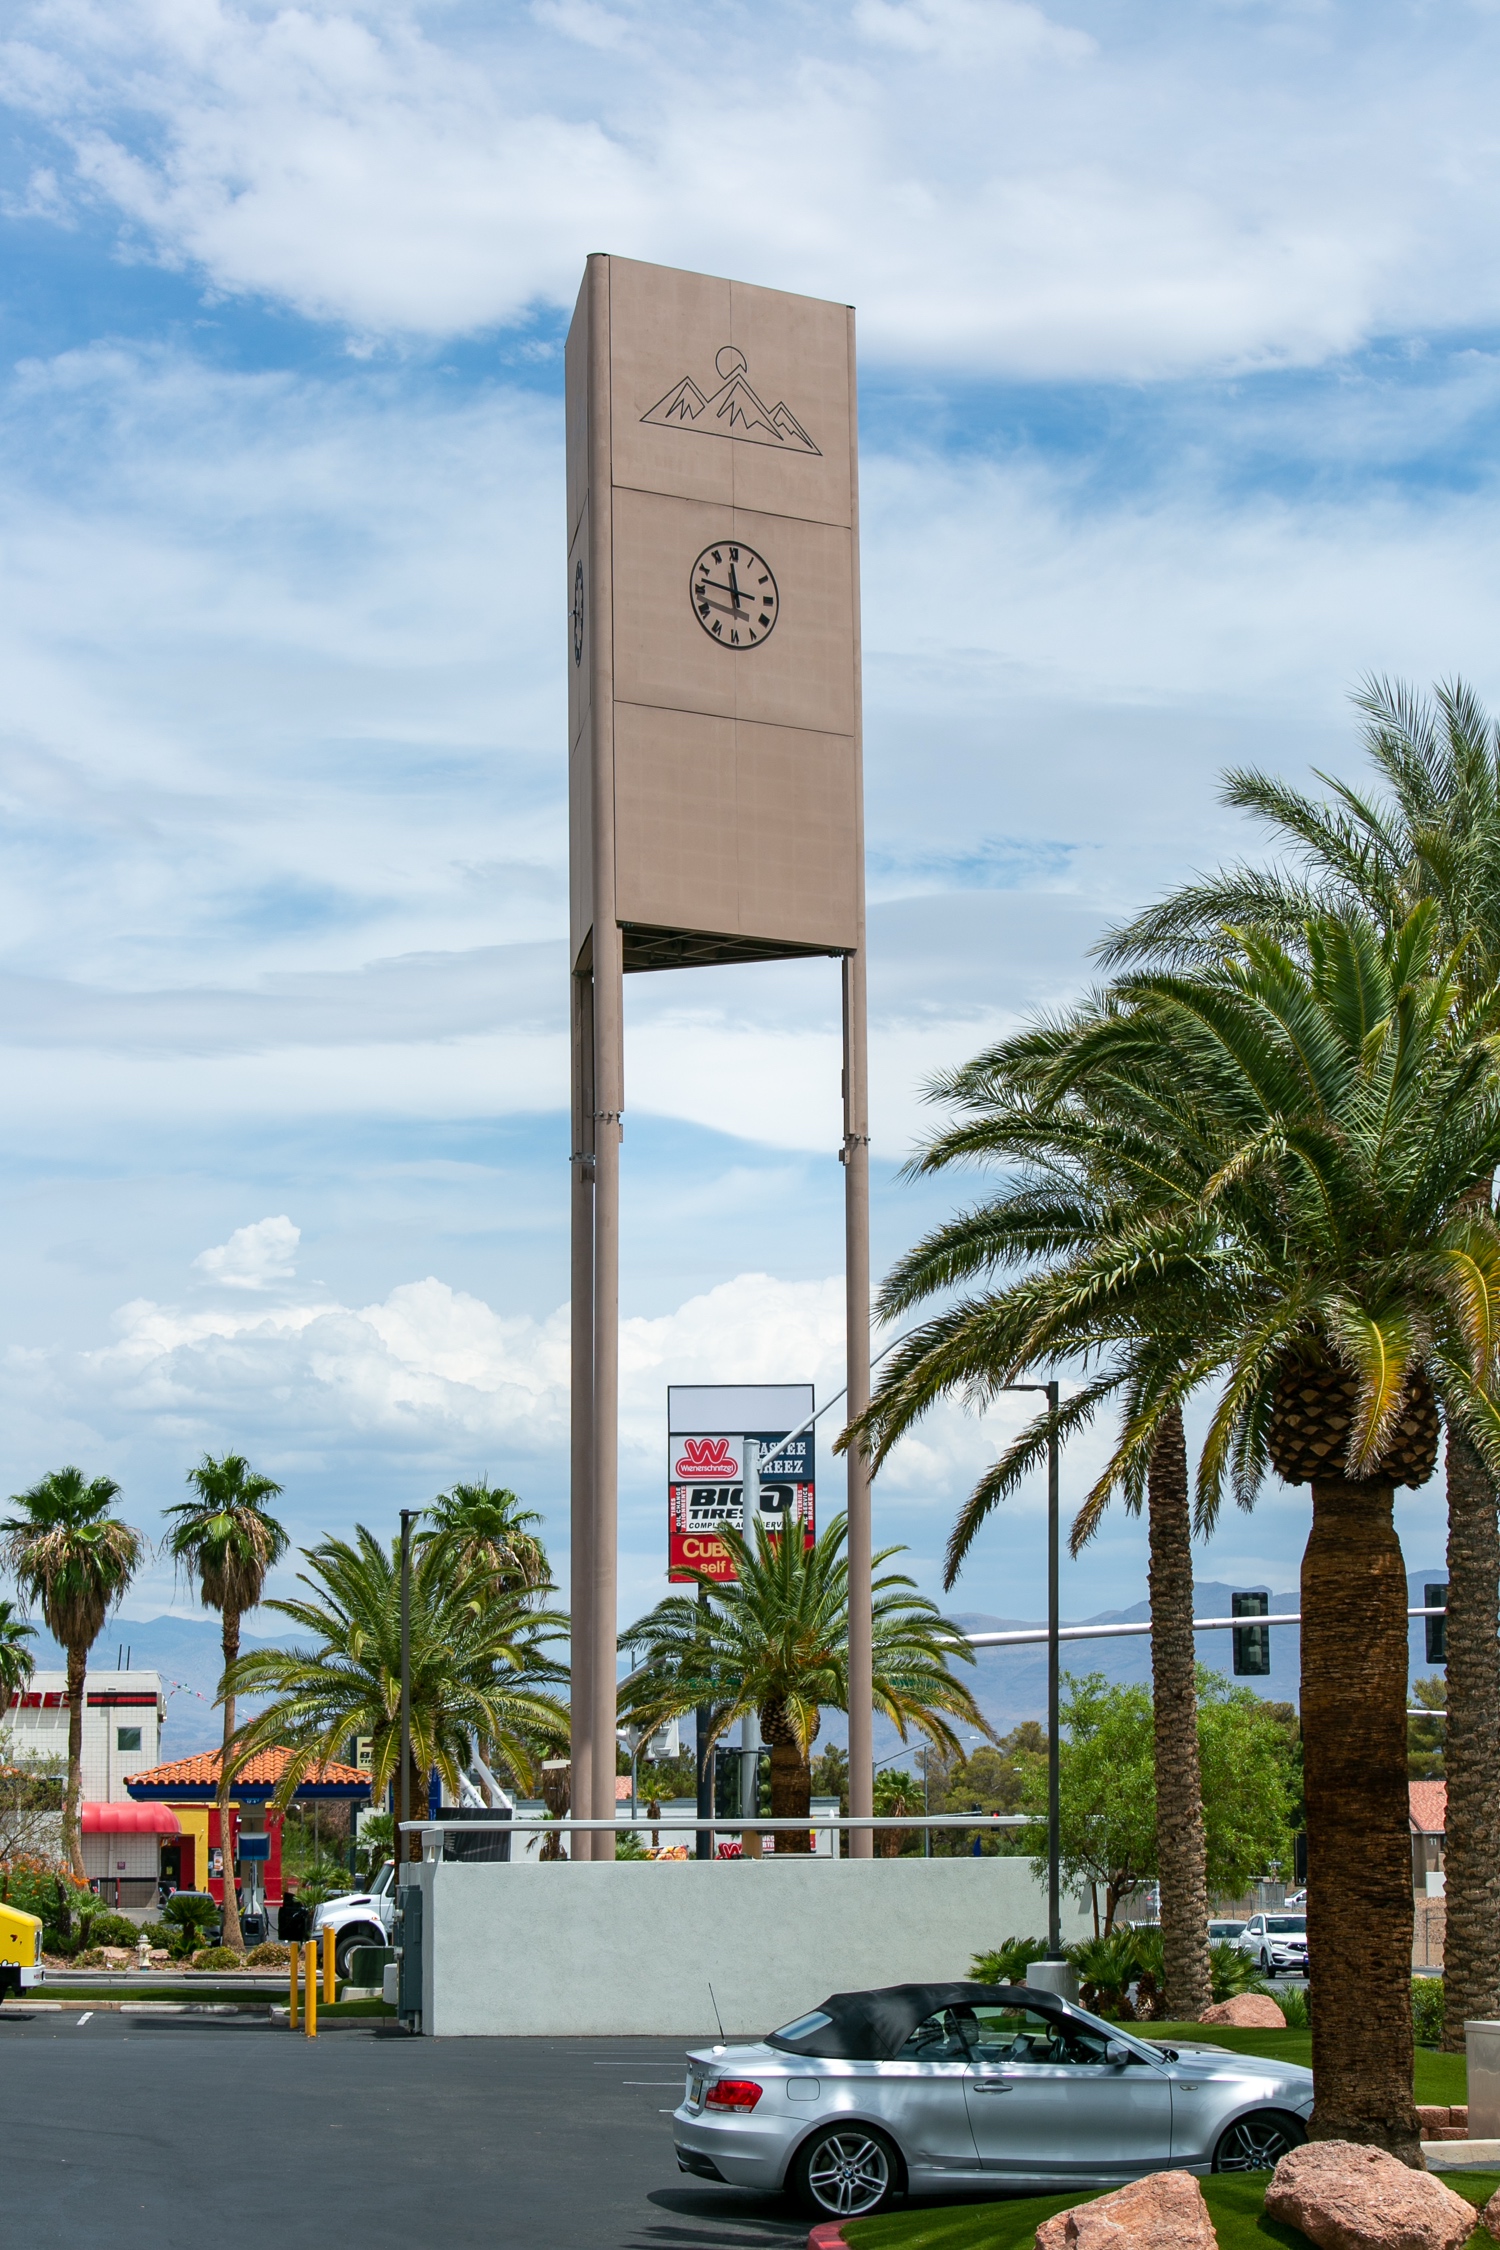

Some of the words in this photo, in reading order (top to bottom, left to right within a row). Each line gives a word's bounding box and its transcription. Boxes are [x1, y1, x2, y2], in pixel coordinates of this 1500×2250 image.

[684, 1438, 730, 1464] W
[680, 1464, 734, 1474] Wienerschnitzel
[700, 1560, 726, 1573] self
